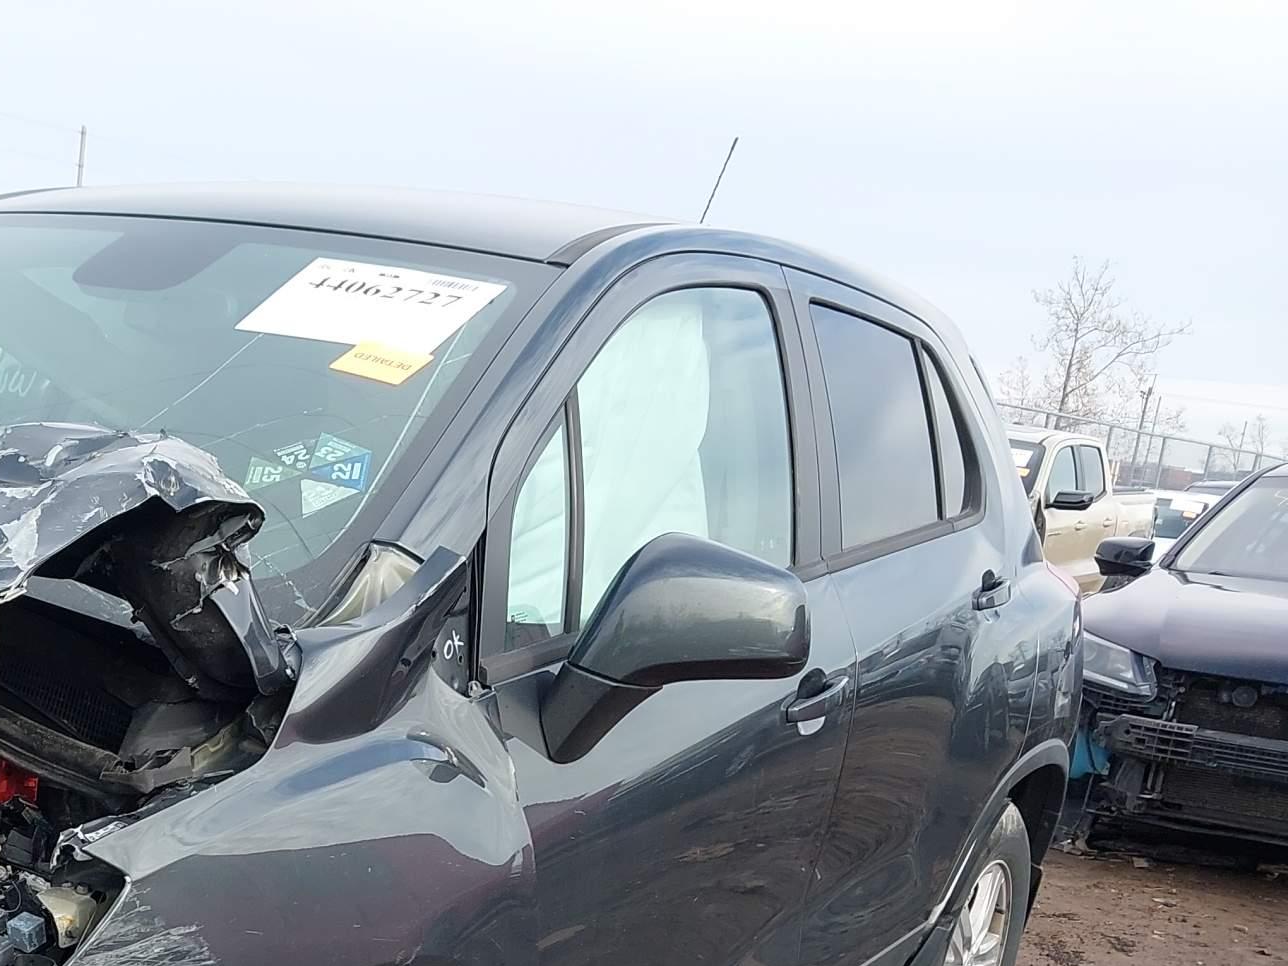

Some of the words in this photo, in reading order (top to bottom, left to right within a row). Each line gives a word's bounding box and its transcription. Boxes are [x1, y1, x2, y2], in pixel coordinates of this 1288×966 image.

[309, 276, 464, 307] 44062727
[261, 465, 283, 482] 25
[331, 462, 351, 480] 22
